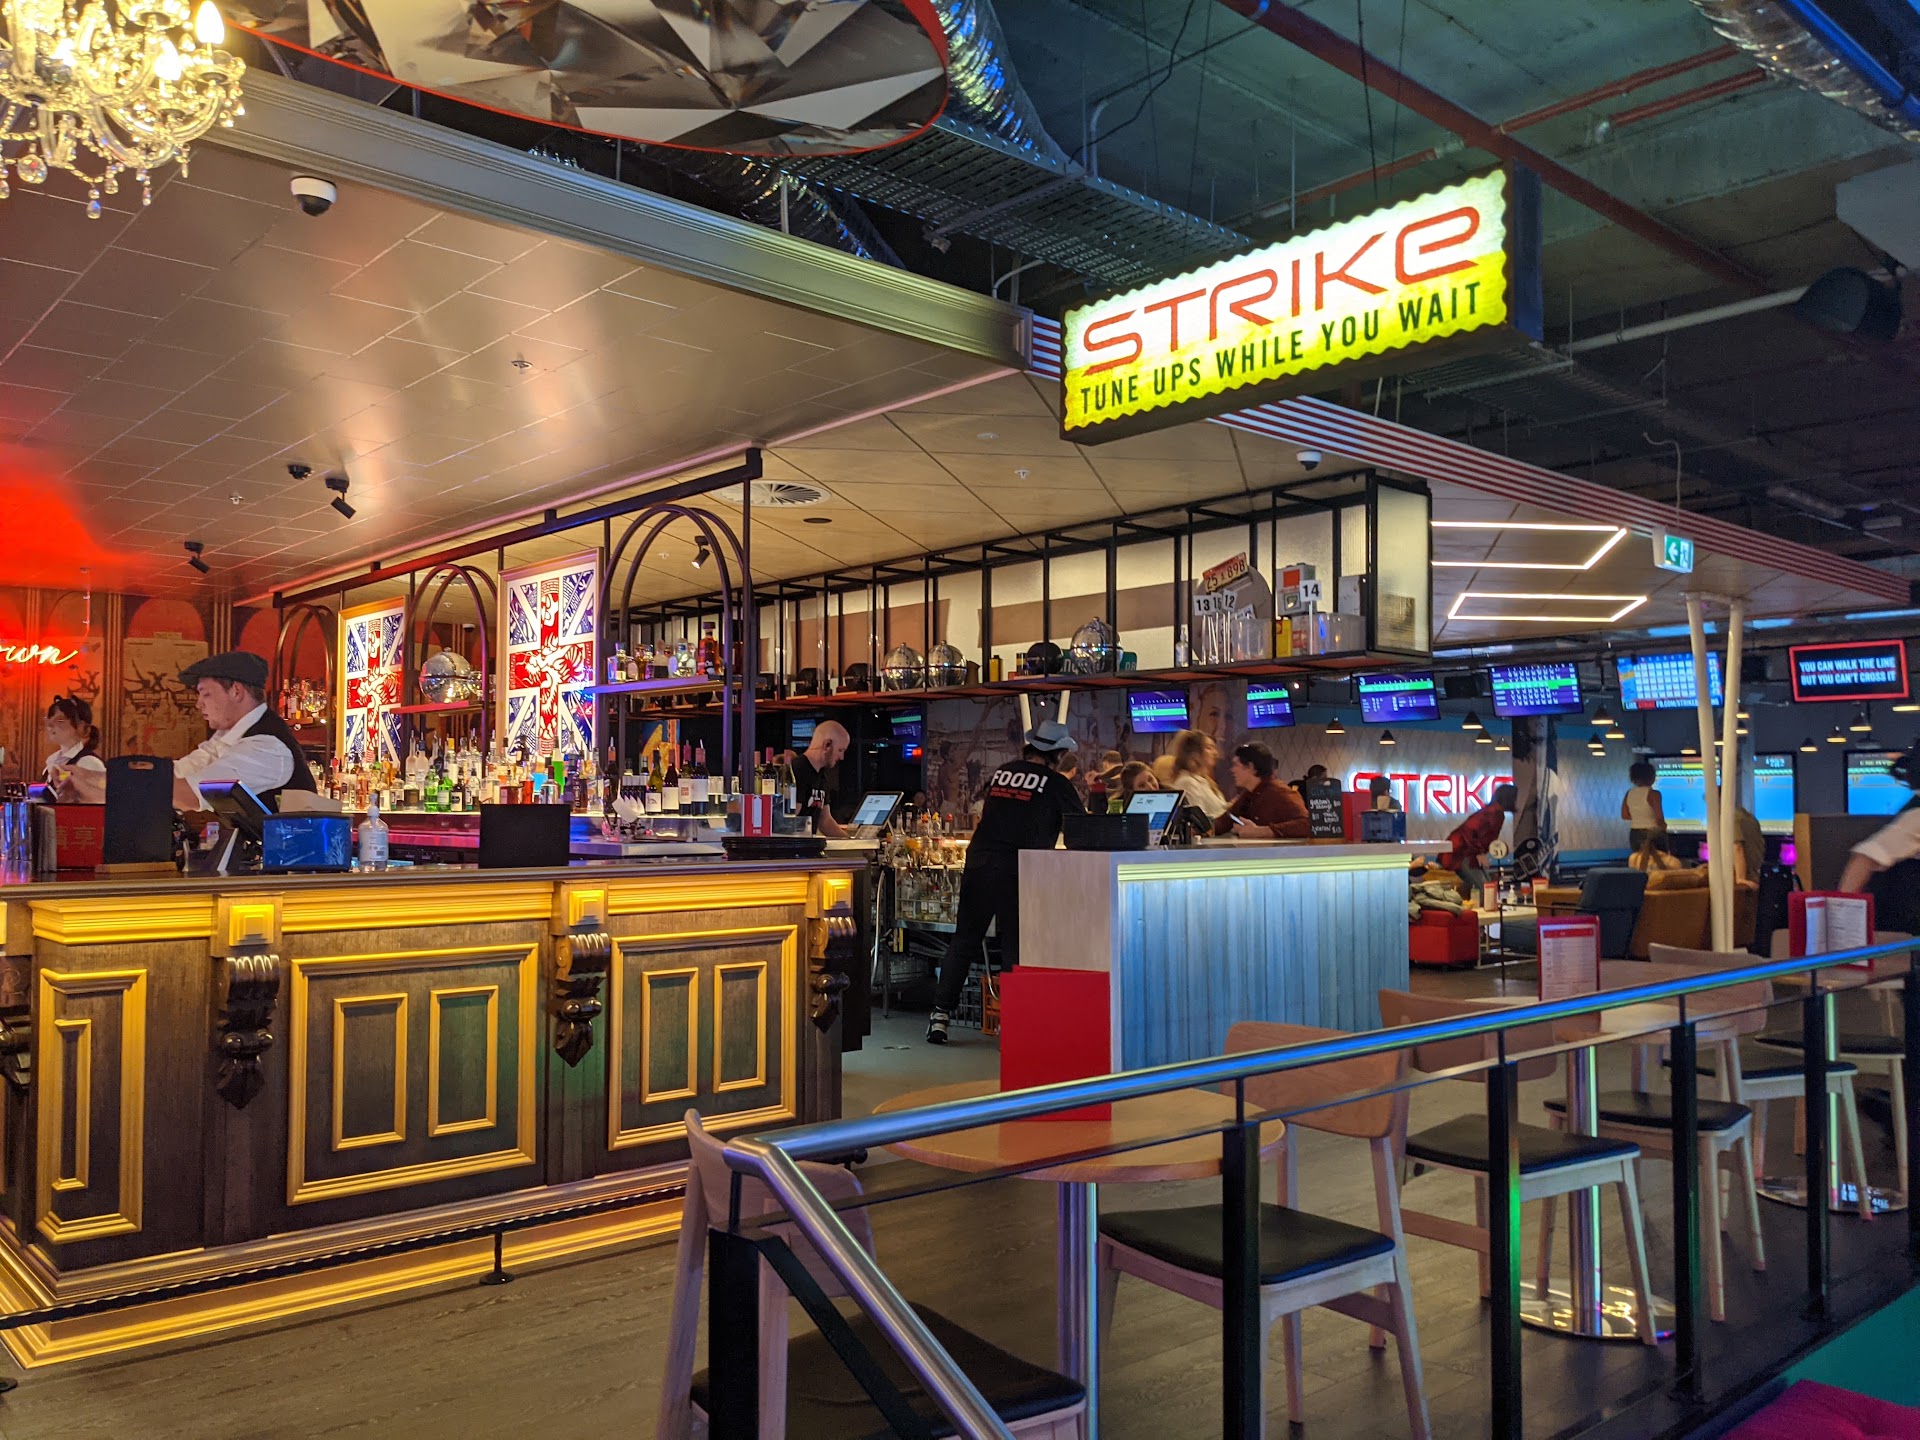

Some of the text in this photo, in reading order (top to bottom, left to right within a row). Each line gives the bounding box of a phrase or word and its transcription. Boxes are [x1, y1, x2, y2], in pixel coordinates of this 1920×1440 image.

[1082, 206, 1480, 377] STRIKE
[1081, 282, 1481, 415] TUNE UPS WHILE YOU WAIT
[1207, 573, 1218, 590] 25
[1227, 560, 1246, 579] 898
[1302, 583, 1320, 598] 14
[1196, 599, 1210, 612] 13
[1225, 594, 1235, 609] 12
[1799, 656, 1896, 673] YOU CAN WALK THE LINE
[1800, 670, 1896, 686] BUT YOU CAN'T CROSS IT
[990, 769, 1049, 794] FOOD!
